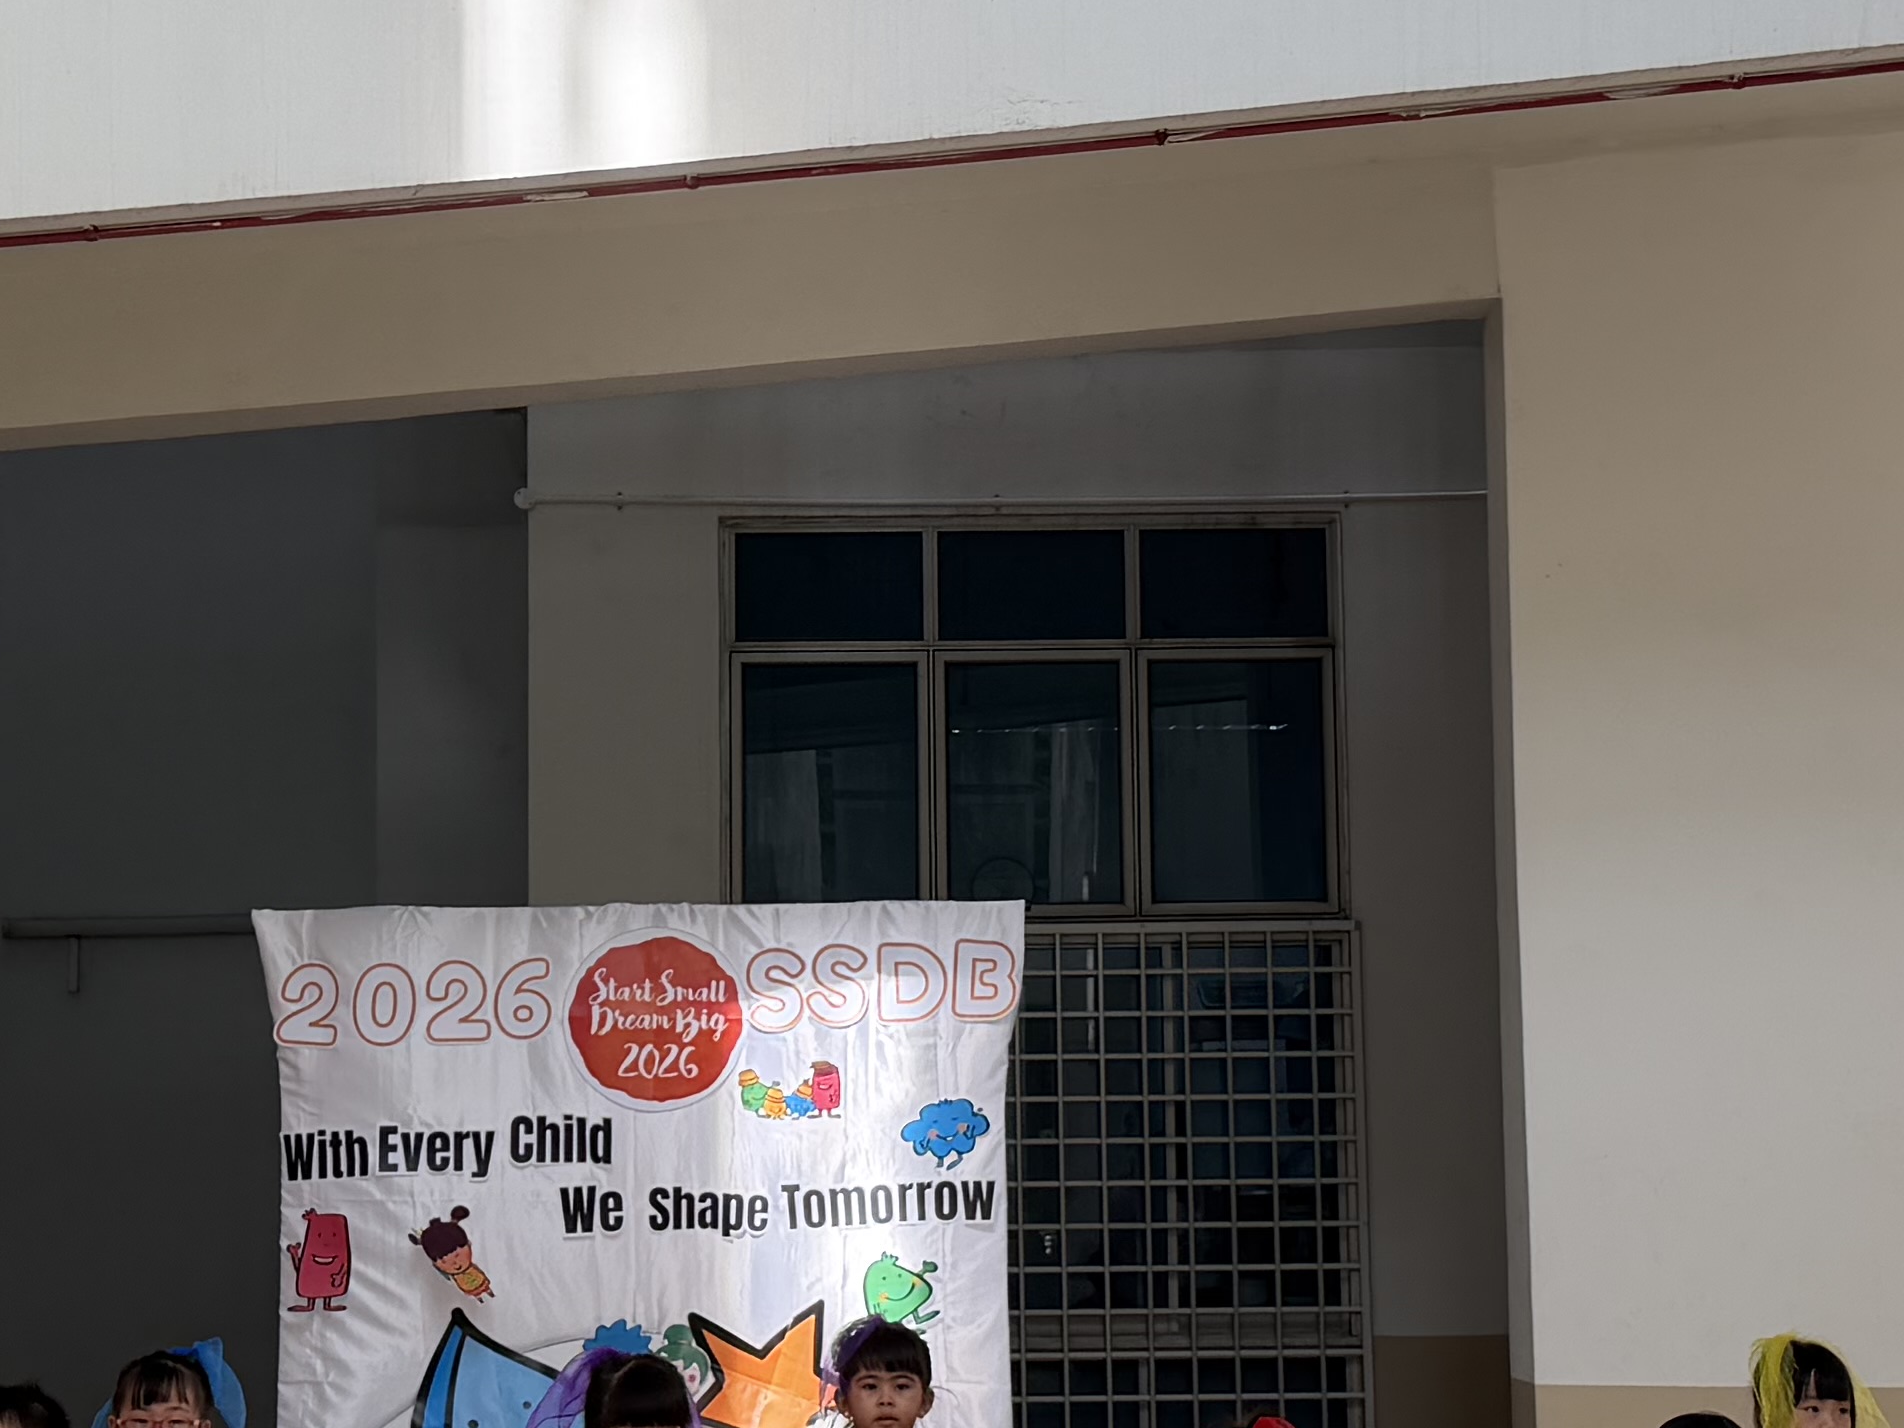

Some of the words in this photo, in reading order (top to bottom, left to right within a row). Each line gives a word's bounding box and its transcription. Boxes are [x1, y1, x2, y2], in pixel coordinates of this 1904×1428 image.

[275, 957, 553, 1047] 2026
[746, 938, 1017, 1033] SSDB
[588, 967, 654, 1005] Start
[656, 969, 729, 1006] Small
[589, 1003, 673, 1036] Dream
[674, 1007, 729, 1043] Big
[617, 1042, 699, 1079] 2026
[283, 1129, 369, 1181] With
[378, 1125, 495, 1179] Every
[509, 1114, 612, 1165] Child
[559, 1185, 624, 1234] We
[648, 1186, 769, 1237] Shape
[781, 1179, 995, 1230] Tomorrow
